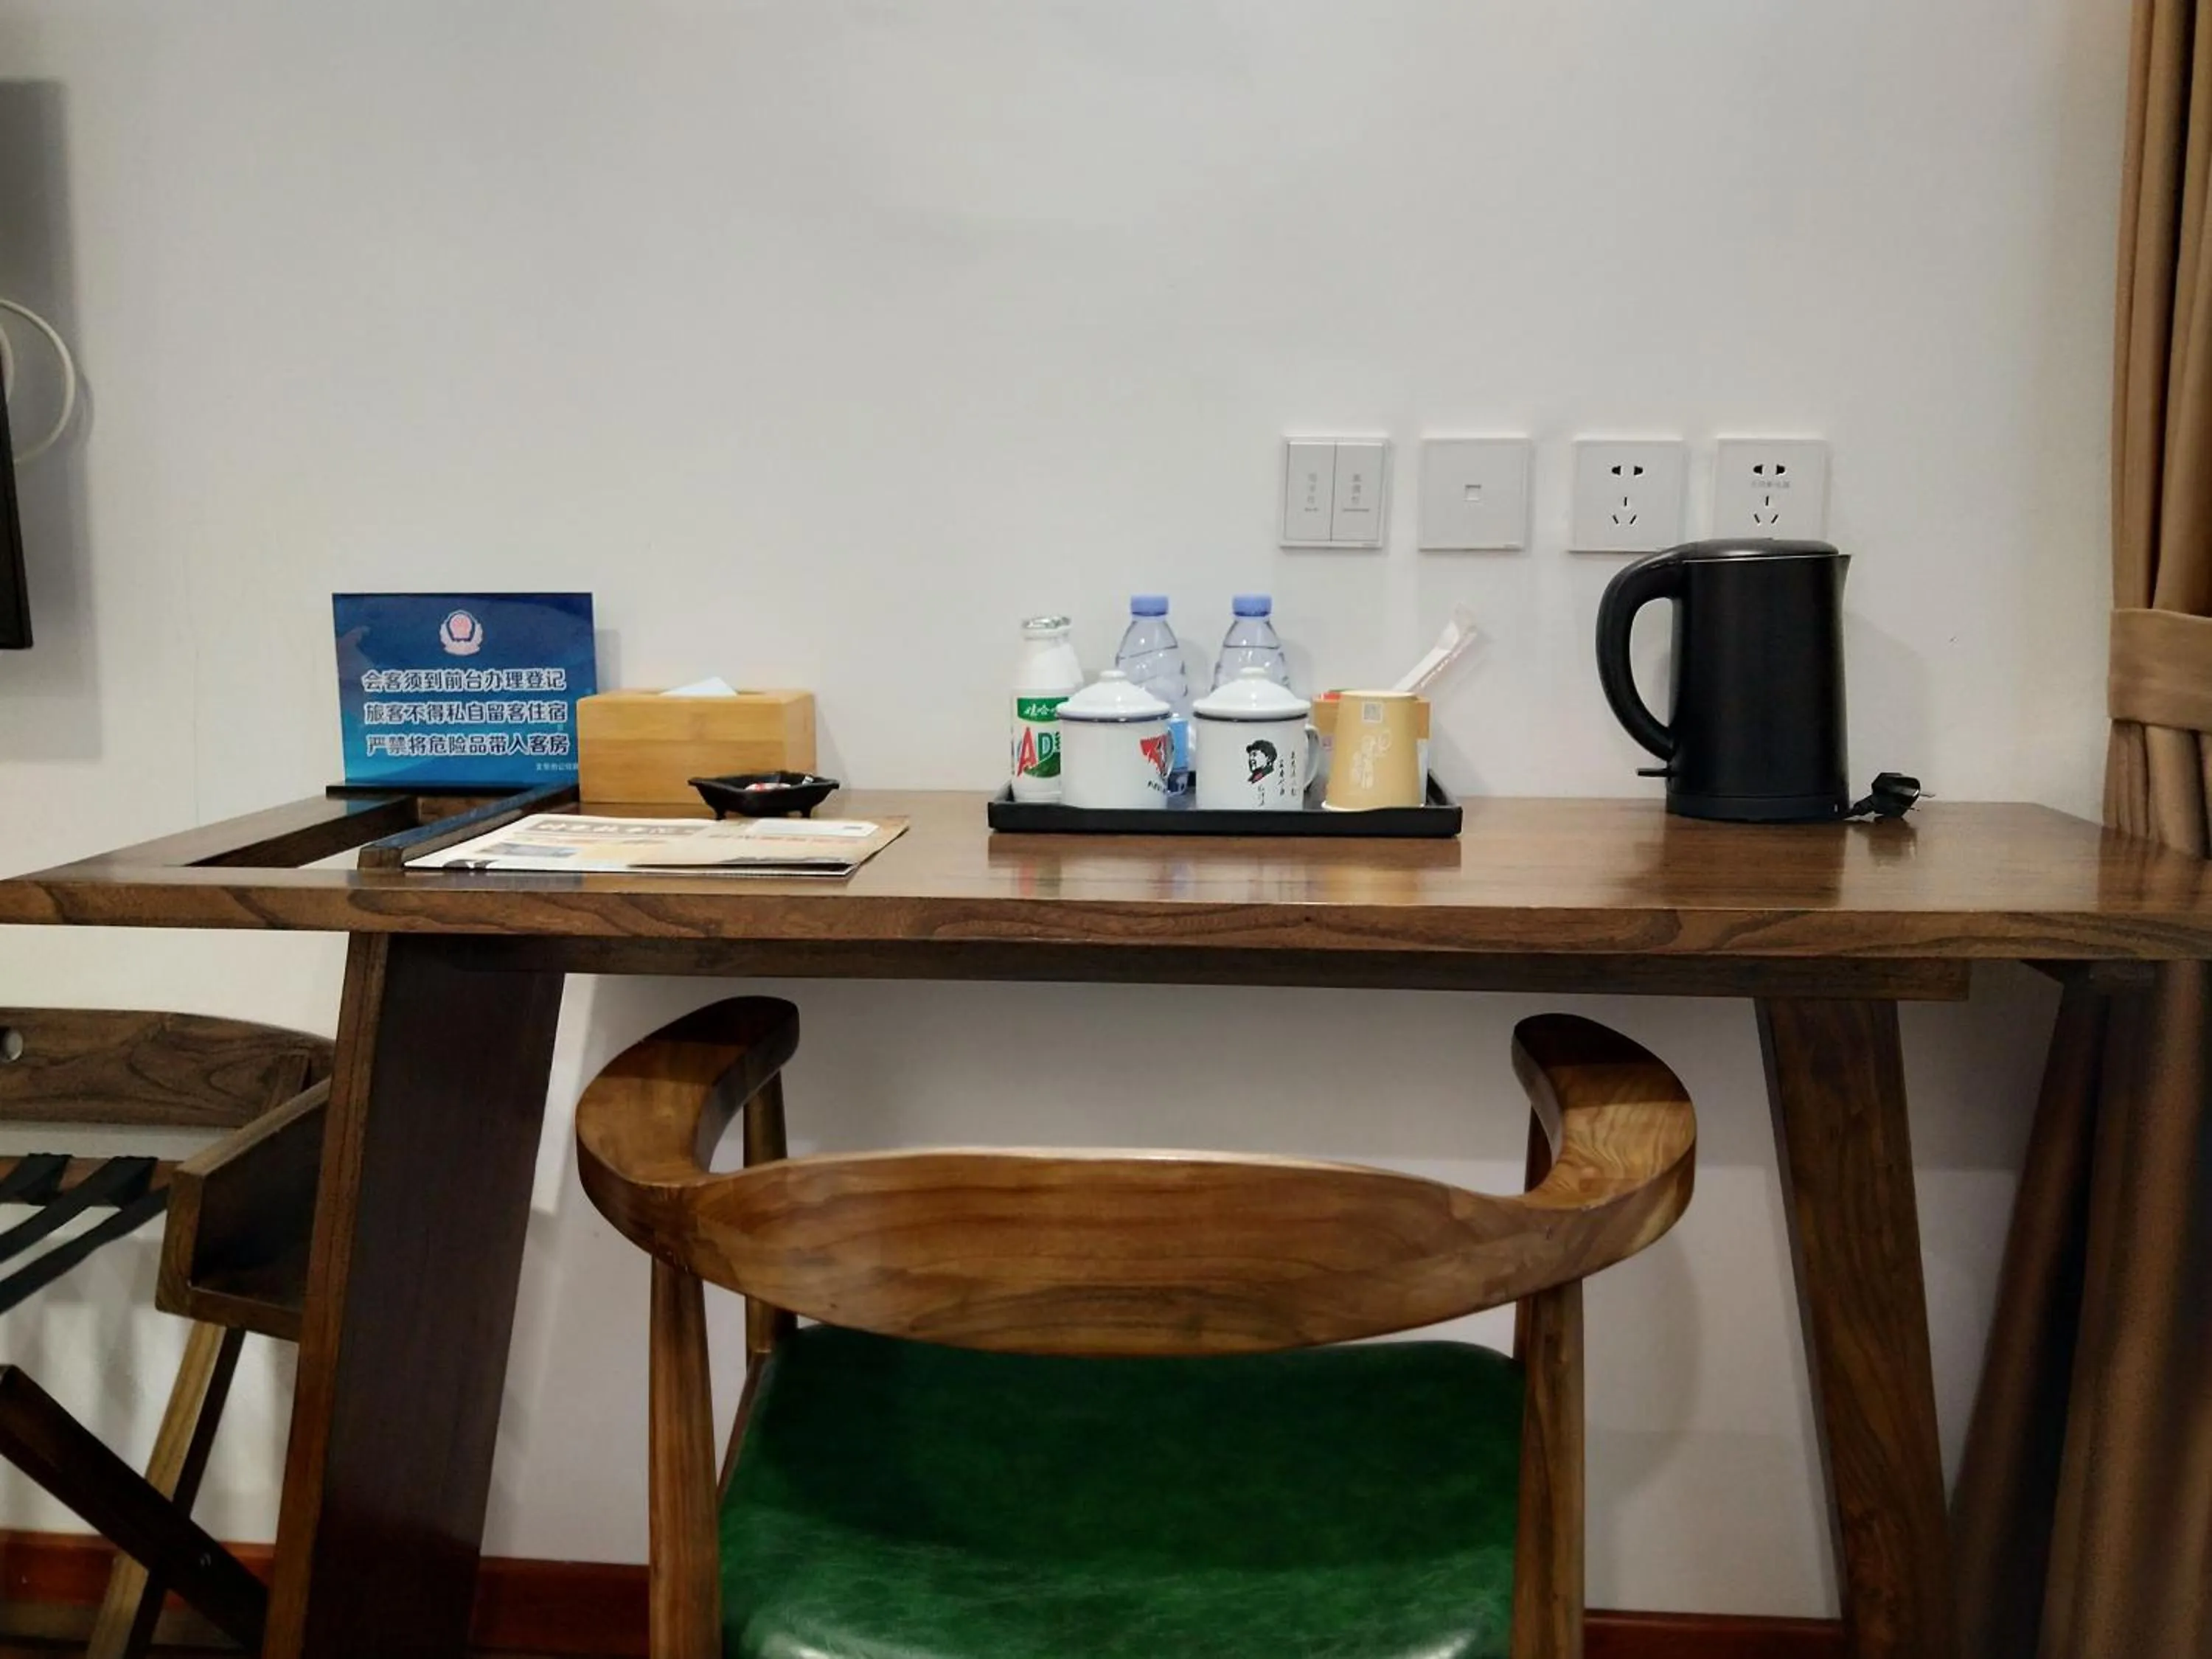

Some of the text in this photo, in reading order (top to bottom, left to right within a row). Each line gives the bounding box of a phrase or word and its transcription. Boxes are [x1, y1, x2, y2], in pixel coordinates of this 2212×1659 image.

[361, 669, 566, 692] 会客须到前台办理登记
[364, 700, 568, 724] 旅客不得私自留客住宿
